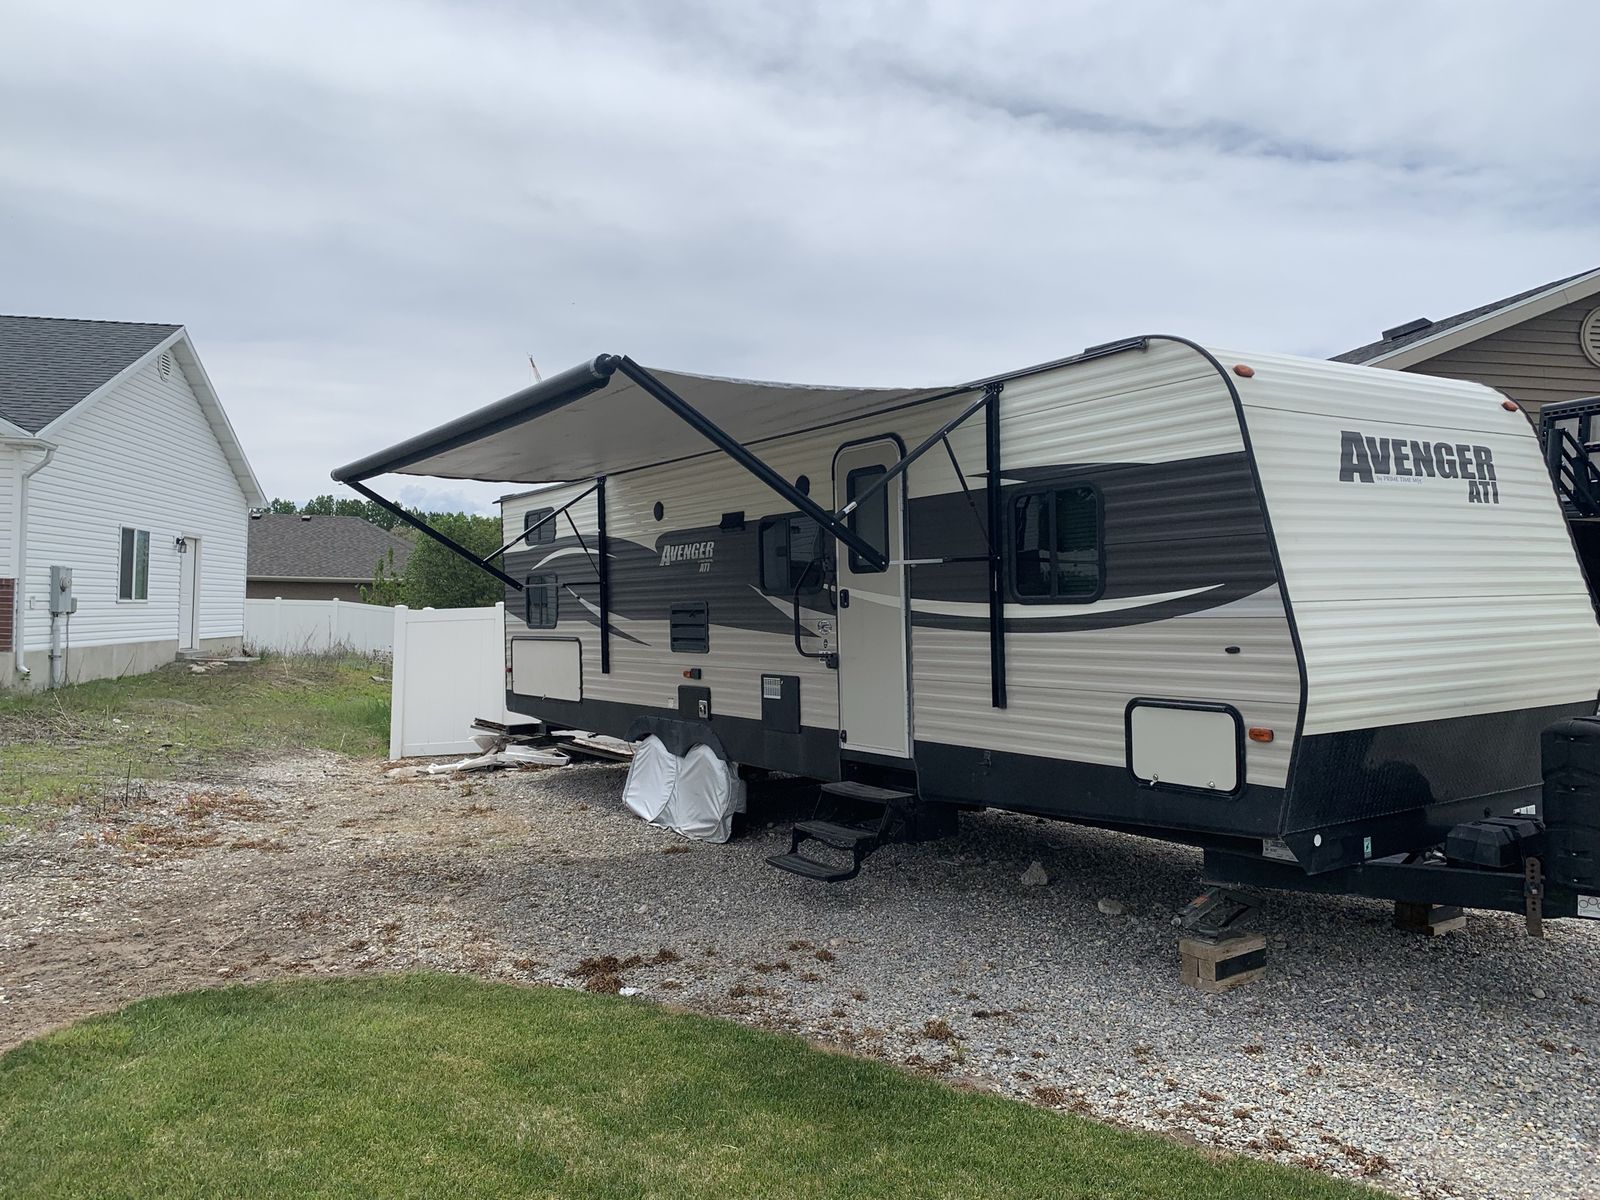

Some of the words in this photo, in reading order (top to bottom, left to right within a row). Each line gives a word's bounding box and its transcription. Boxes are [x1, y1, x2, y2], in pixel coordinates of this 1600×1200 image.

[1339, 430, 1497, 483] AVENGER
[1468, 480, 1499, 504] ATI
[659, 541, 715, 567] AVENGER
